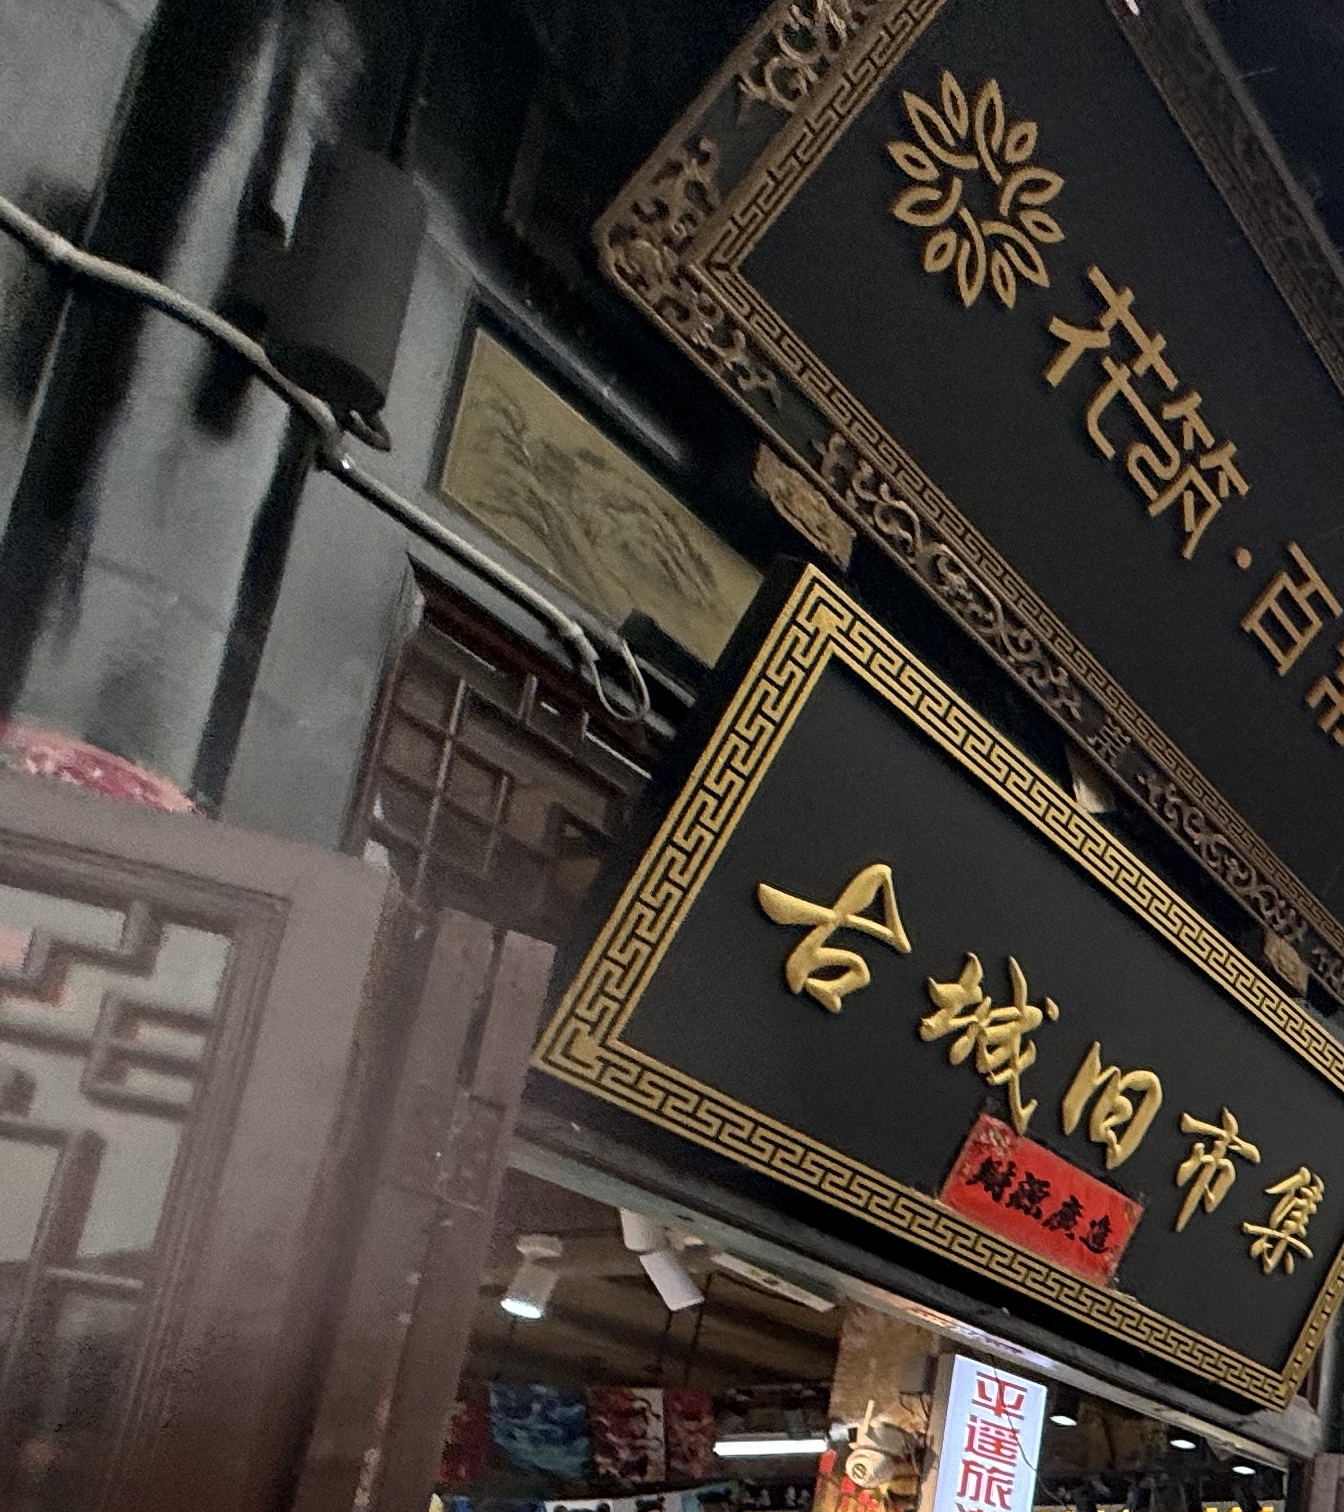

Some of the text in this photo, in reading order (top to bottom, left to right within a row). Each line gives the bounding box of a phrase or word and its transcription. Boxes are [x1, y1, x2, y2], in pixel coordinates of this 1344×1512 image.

[756, 863, 1327, 1276] 古城旧市集
